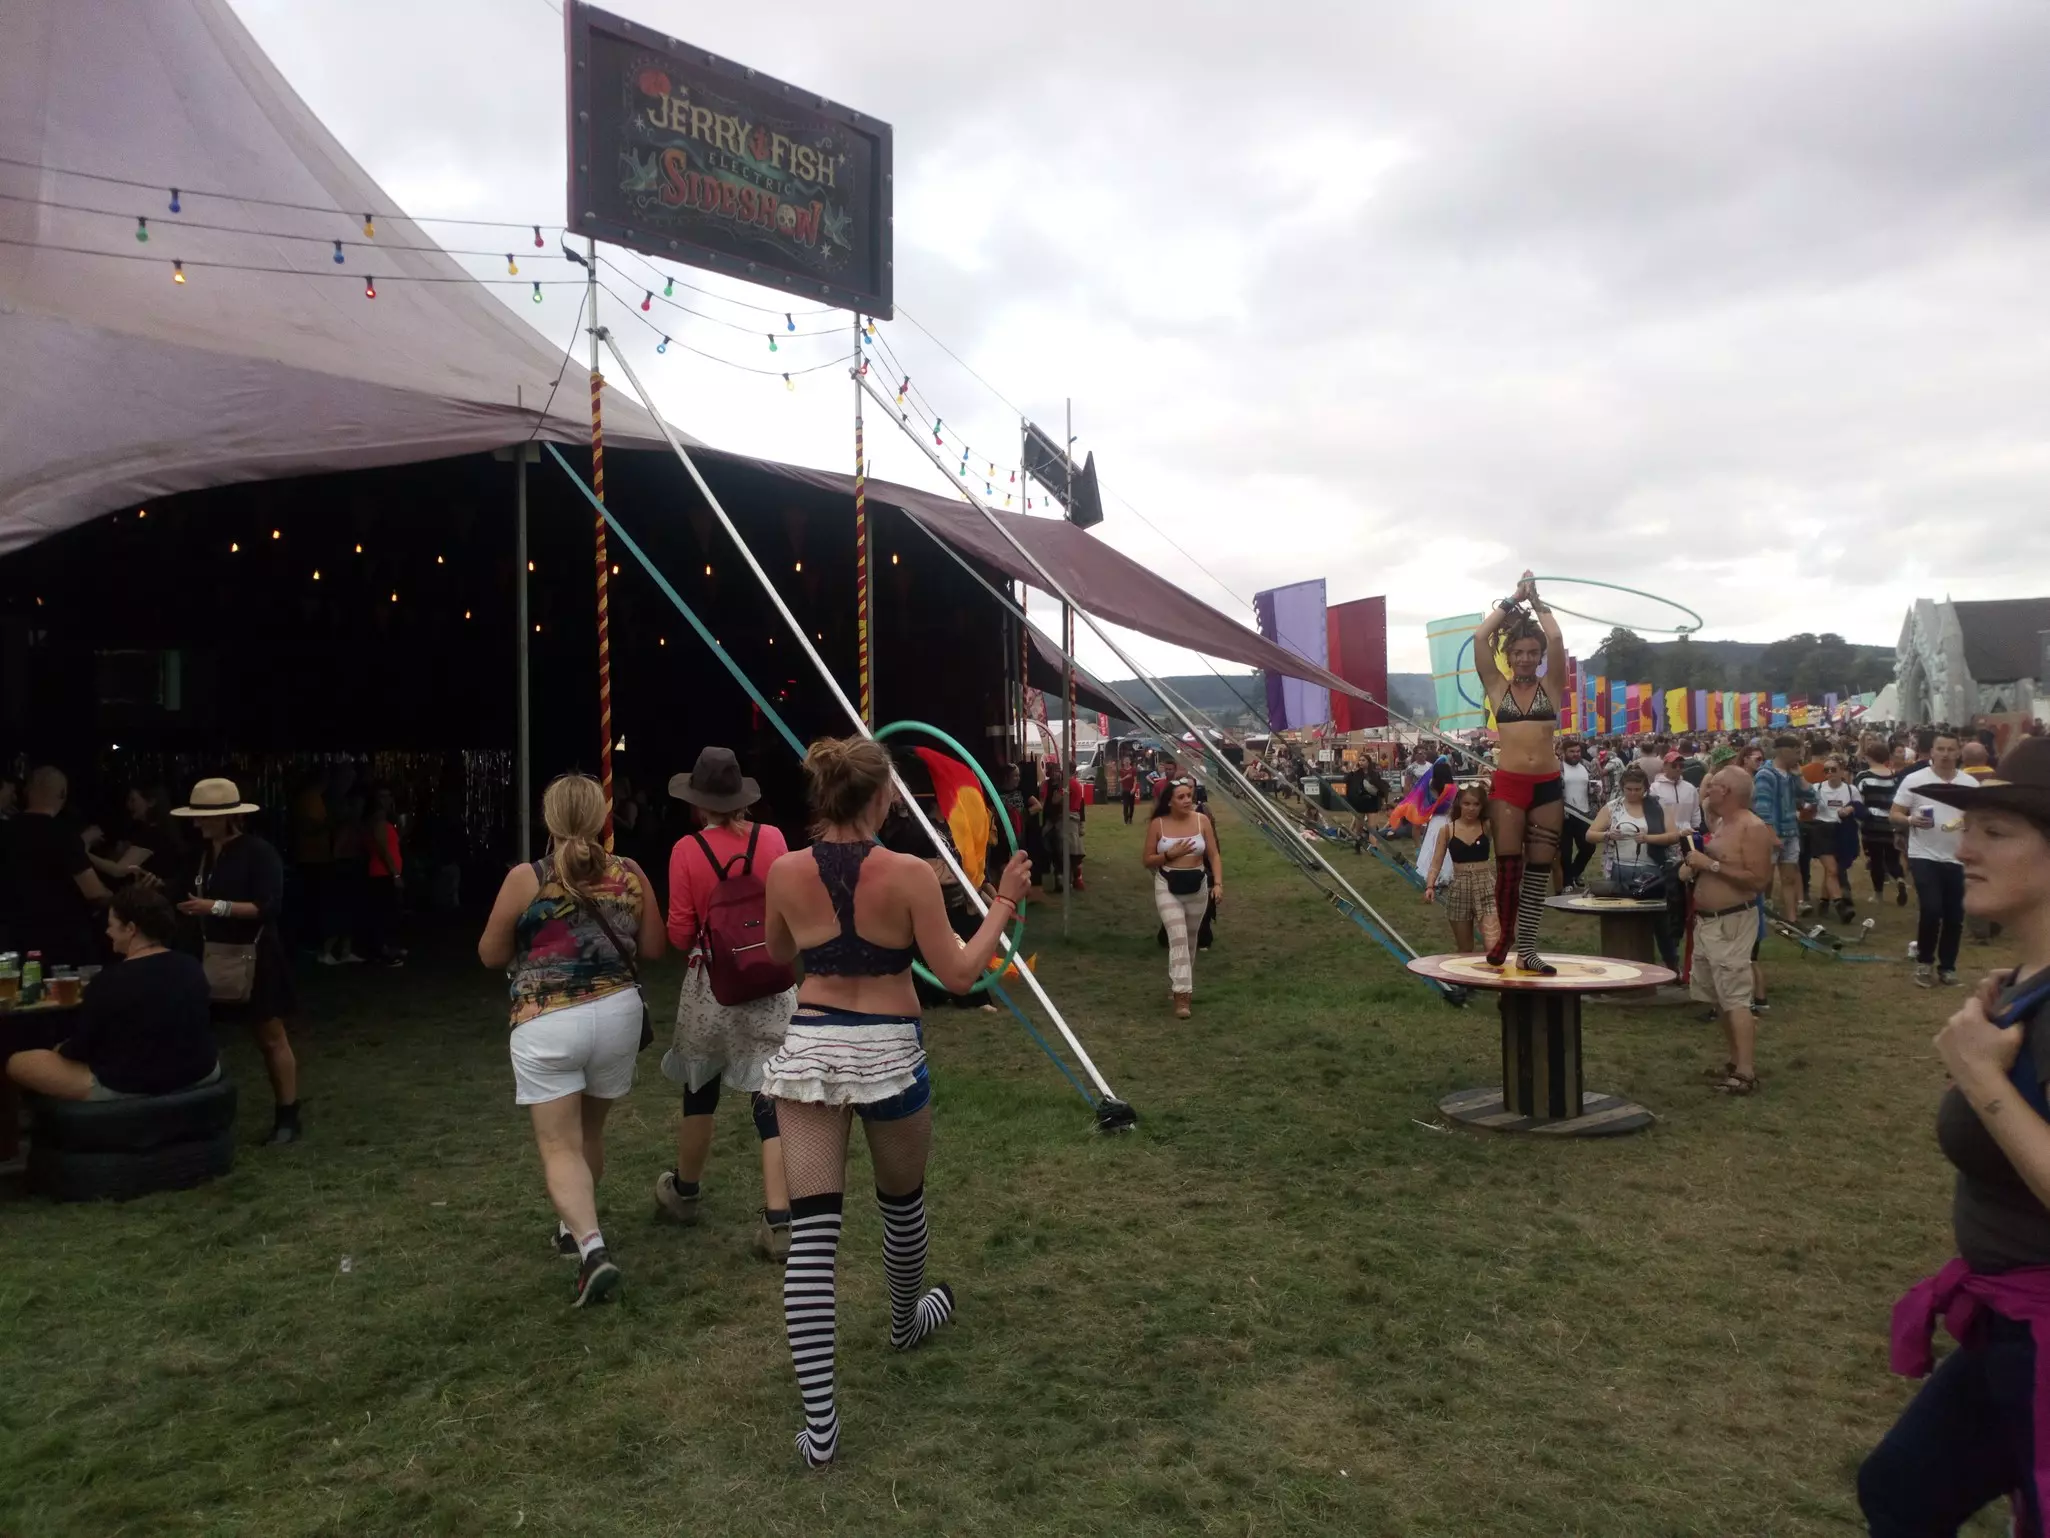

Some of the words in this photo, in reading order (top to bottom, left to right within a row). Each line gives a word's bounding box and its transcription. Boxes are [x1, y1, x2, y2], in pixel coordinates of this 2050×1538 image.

[648, 93, 751, 155] JERRY
[772, 132, 836, 187] FISH
[708, 154, 792, 194] ELECTRIC
[660, 149, 823, 248] SIDESHOW
